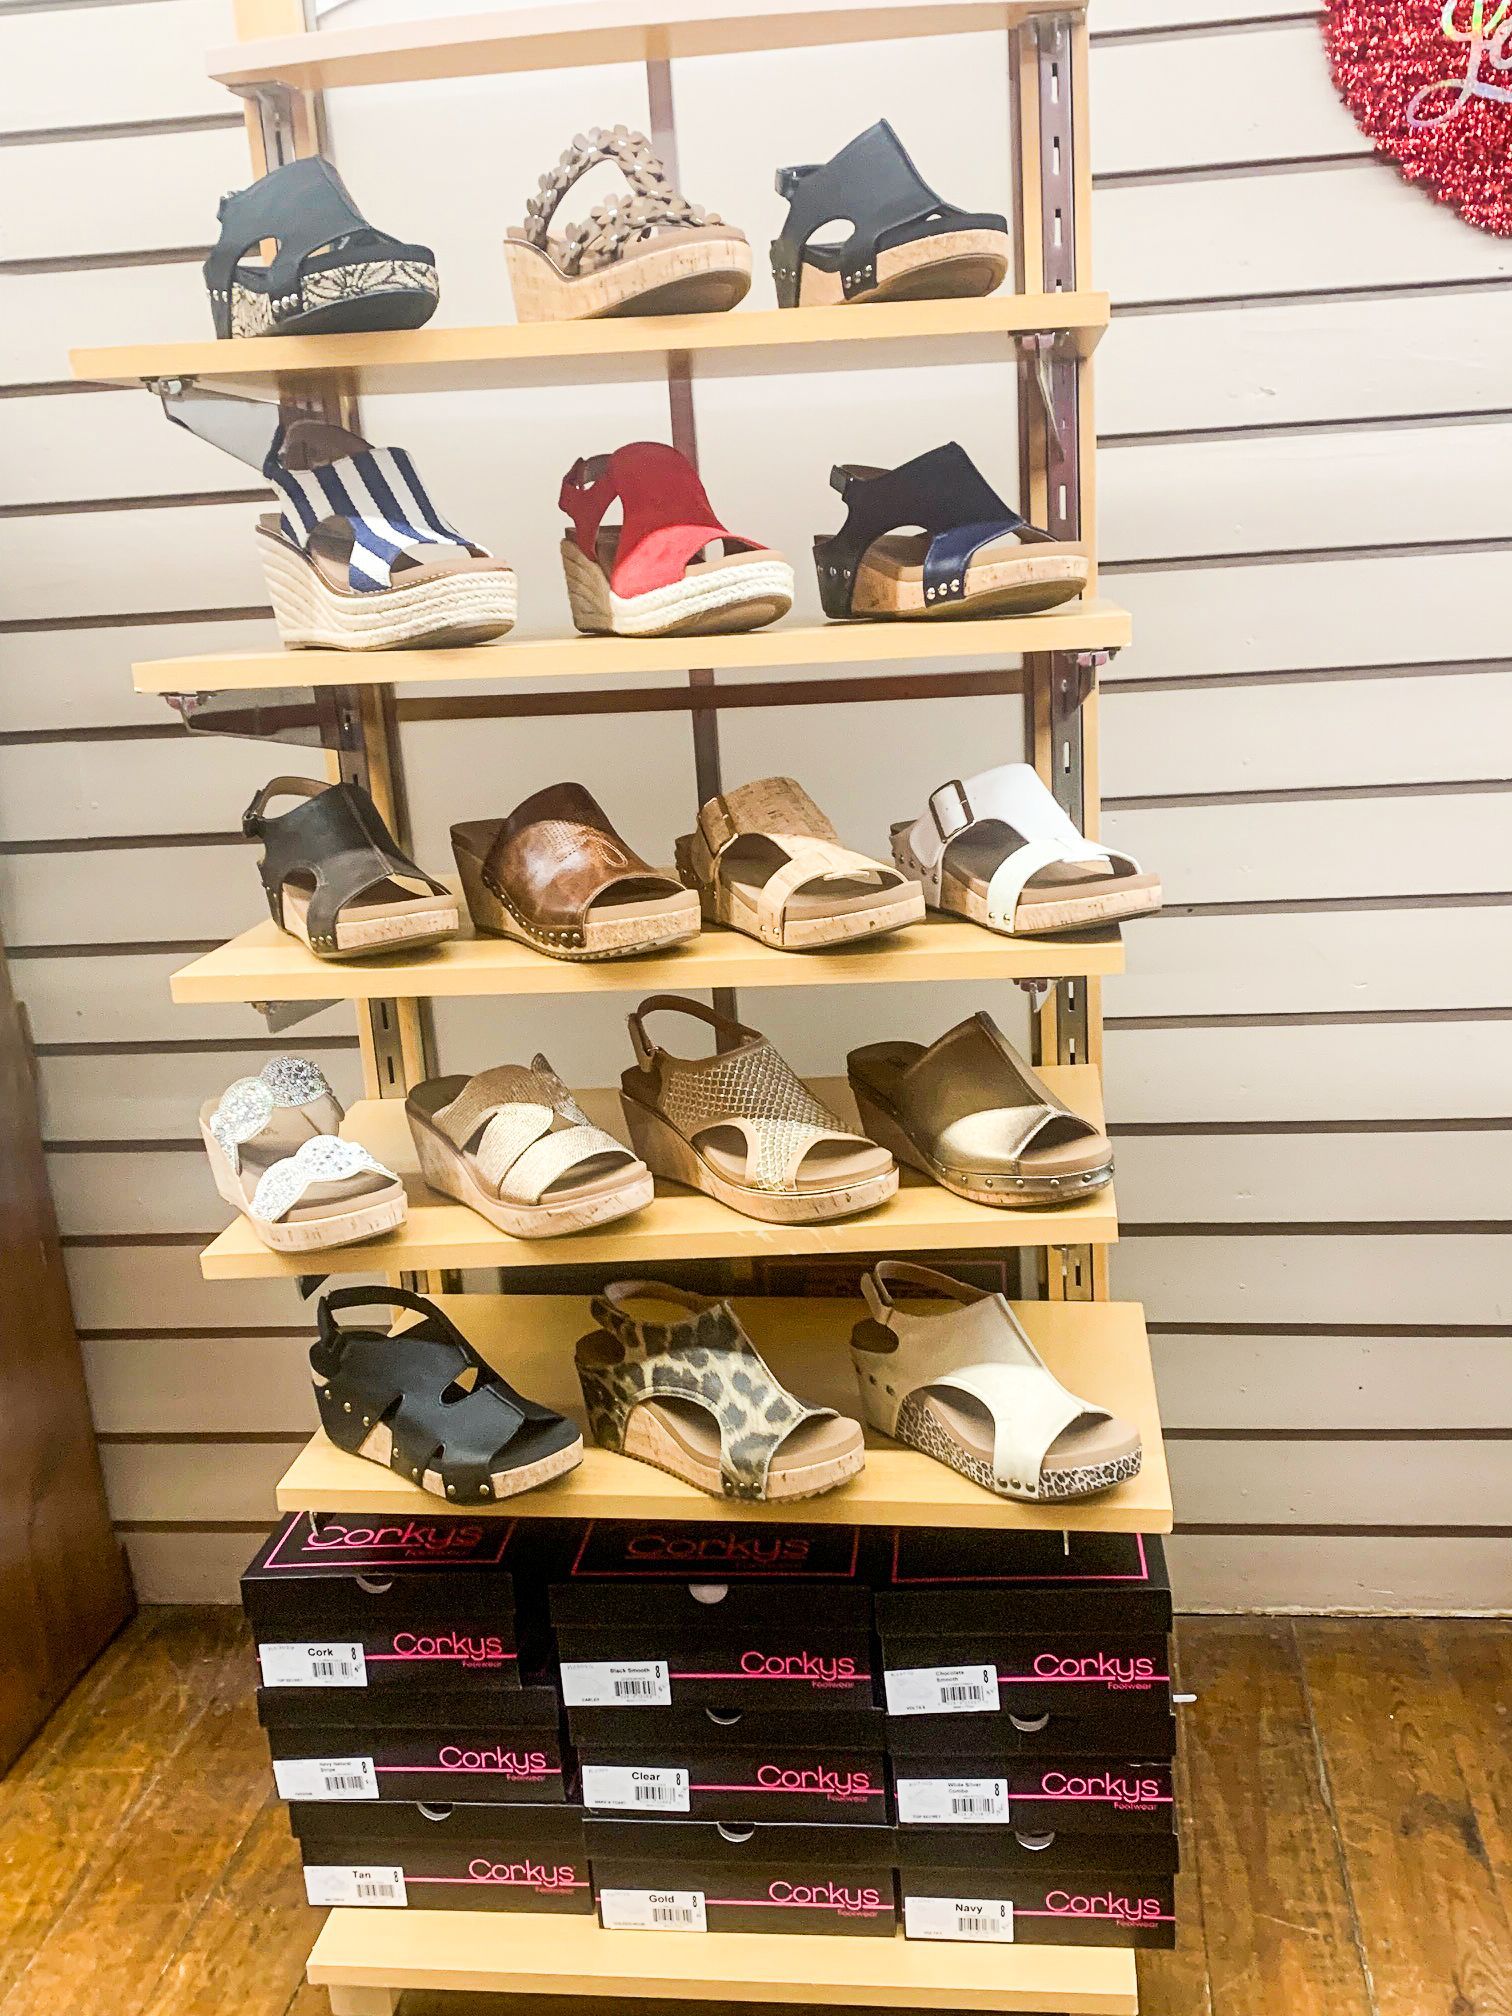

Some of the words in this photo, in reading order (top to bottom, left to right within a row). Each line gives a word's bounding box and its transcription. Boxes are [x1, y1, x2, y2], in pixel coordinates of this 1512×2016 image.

[307, 1521, 484, 1549] Corkys
[307, 1647, 334, 1656] Cork
[393, 1631, 503, 1661] Corkys
[655, 1665, 661, 1679] 8
[740, 1650, 856, 1682] Corkys
[983, 1669, 989, 1684] 8
[1033, 1652, 1154, 1683] Corkys
[439, 1745, 547, 1775] Corkys
[631, 1771, 661, 1780] Clear
[757, 1765, 870, 1796] Corkys
[1041, 1772, 1159, 1803] Corkys
[994, 1783, 1000, 1797] 8
[352, 1870, 371, 1879] Tan
[468, 1858, 575, 1888] Corkys
[648, 1894, 675, 1903] Gold
[768, 1881, 880, 1911] Corkys
[955, 1903, 983, 1914] Navy
[1045, 1890, 1161, 1921] Corkys
[1000, 1904, 1006, 1918] 8
